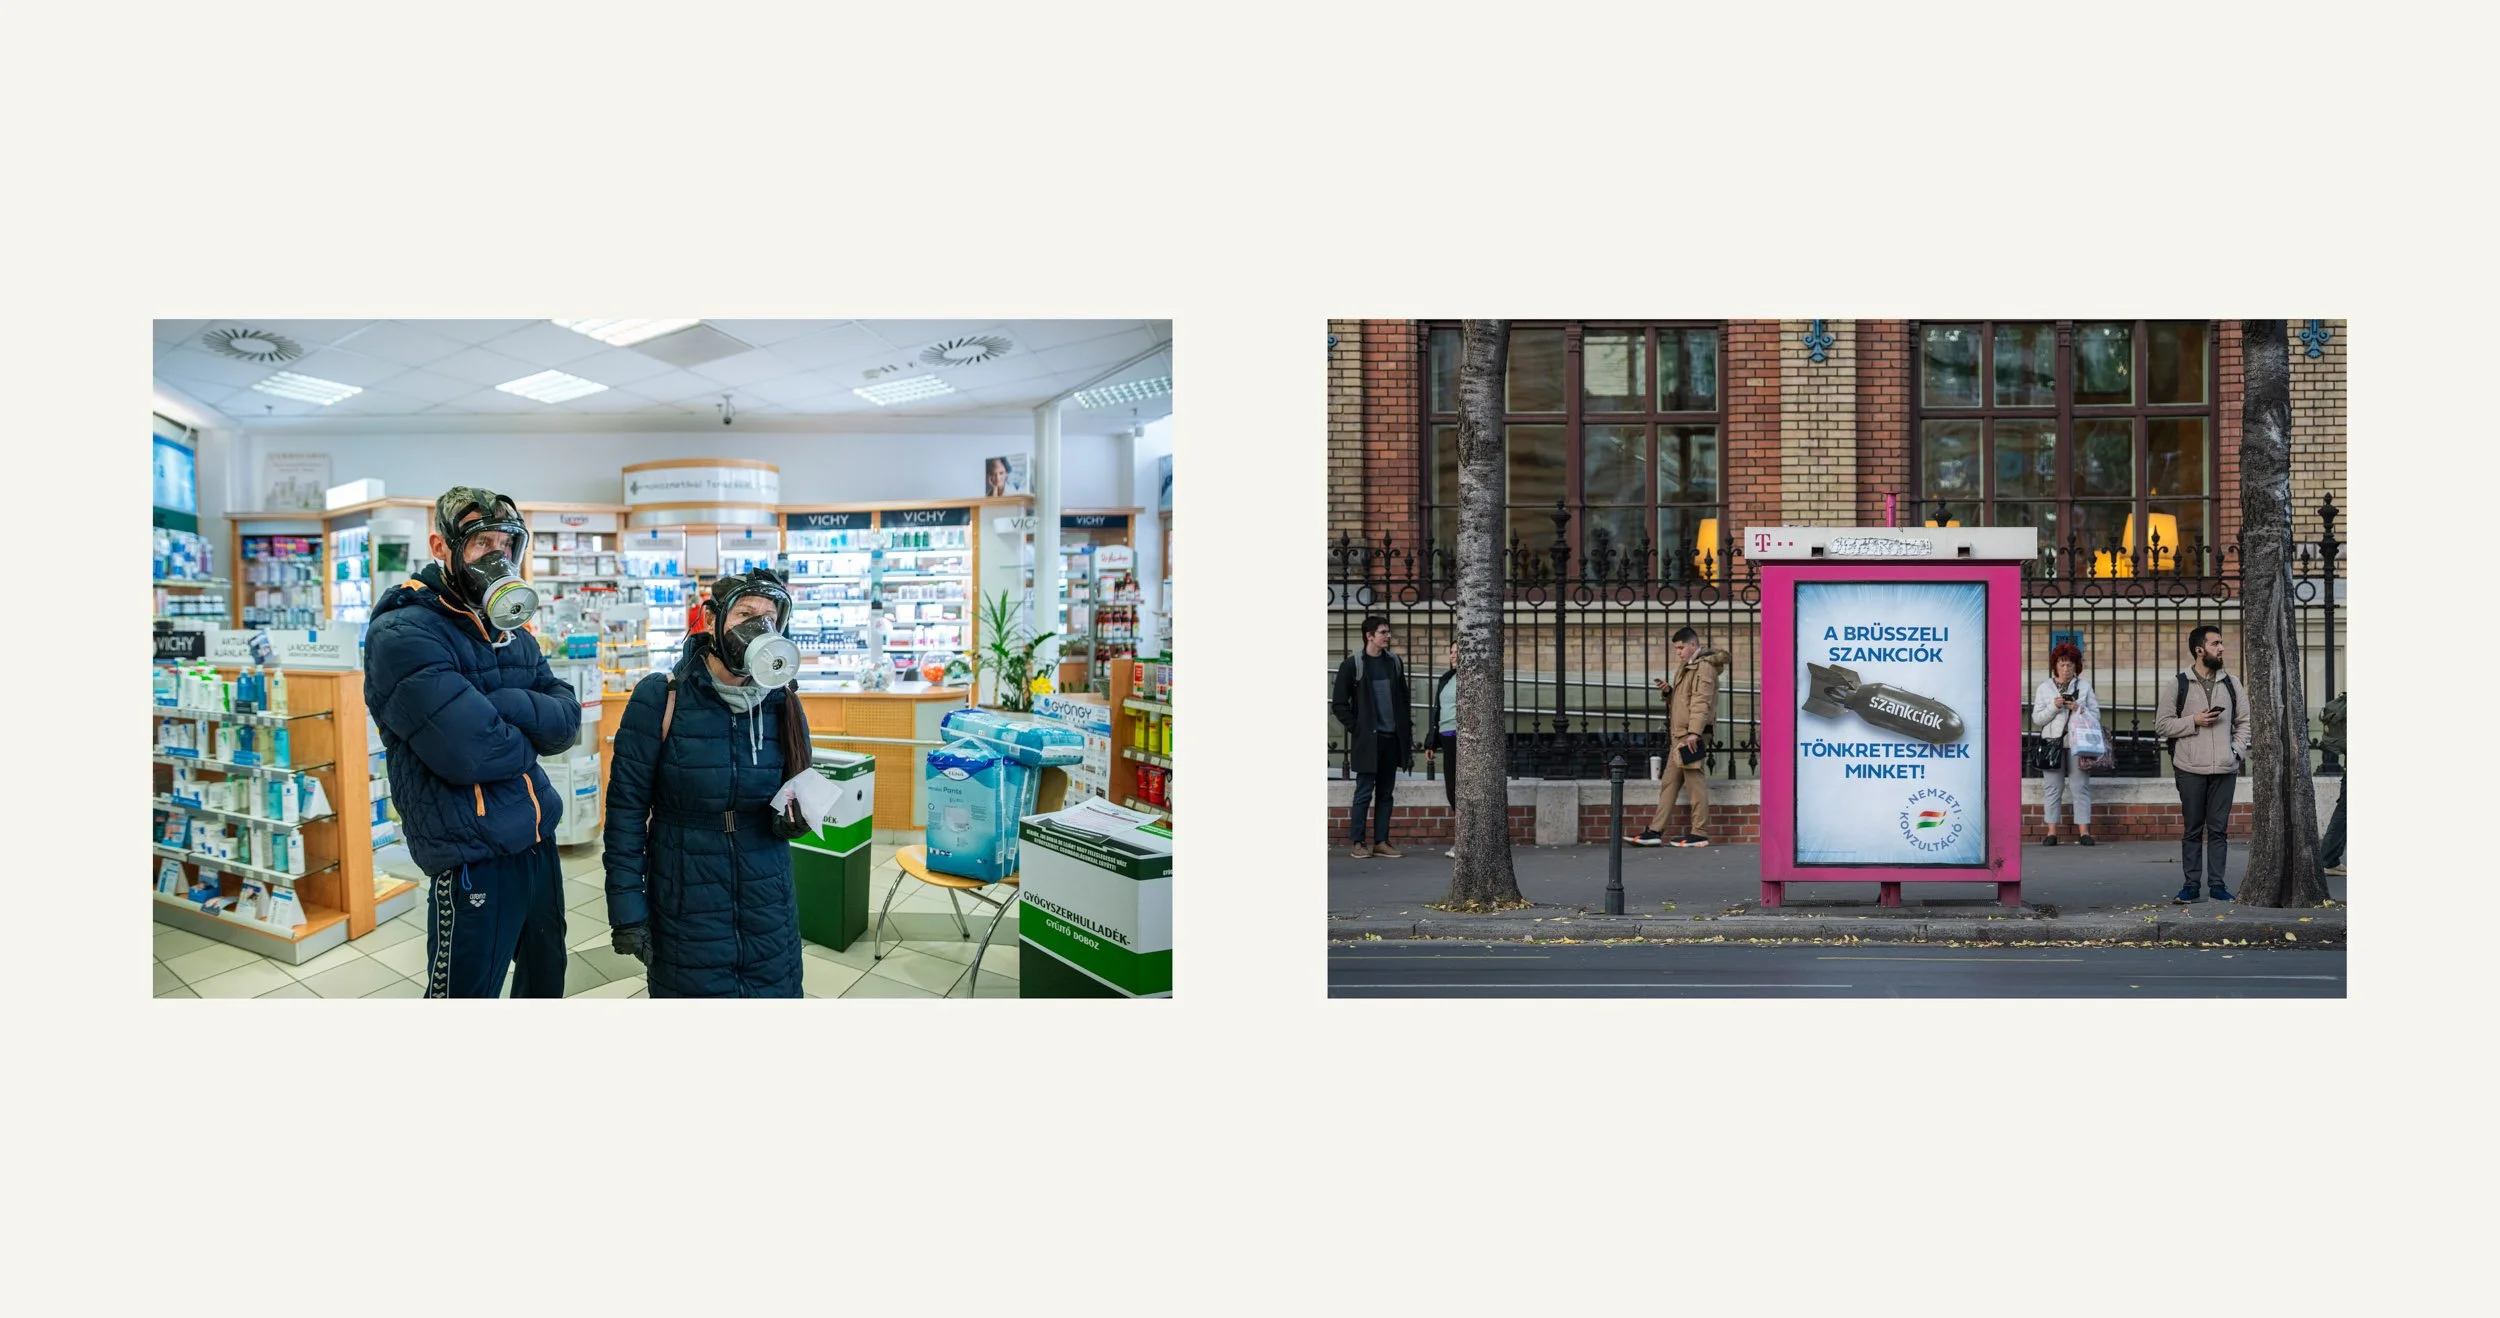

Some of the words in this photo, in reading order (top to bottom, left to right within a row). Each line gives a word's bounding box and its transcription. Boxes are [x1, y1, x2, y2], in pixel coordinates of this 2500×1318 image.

[808, 514, 849, 526] VICHY
[903, 510, 947, 523] VICHY
[1076, 516, 1106, 525] VICHY
[1823, 626, 1839, 641] A
[1843, 622, 1949, 642] BRÜSSZELI
[156, 636, 196, 651] VICHY
[1828, 643, 1944, 663] SZANKCIÓK
[1051, 701, 1092, 719] GYÖNGY
[1869, 696, 1944, 731] szankciók
[1799, 738, 1971, 759] TÖNKRETESZNEK
[1844, 764, 1925, 780] MINKET!
[943, 786, 963, 795] Pants
[1907, 788, 1962, 814] NEMZETI
[1899, 811, 1963, 852] KONZULTÁCIÓ
[1023, 890, 1131, 946] GYÓGYSZERHULLADÉK-
[1045, 918, 1071, 937] GYŰJTŐ
[1073, 931, 1100, 951] DOBOZ
